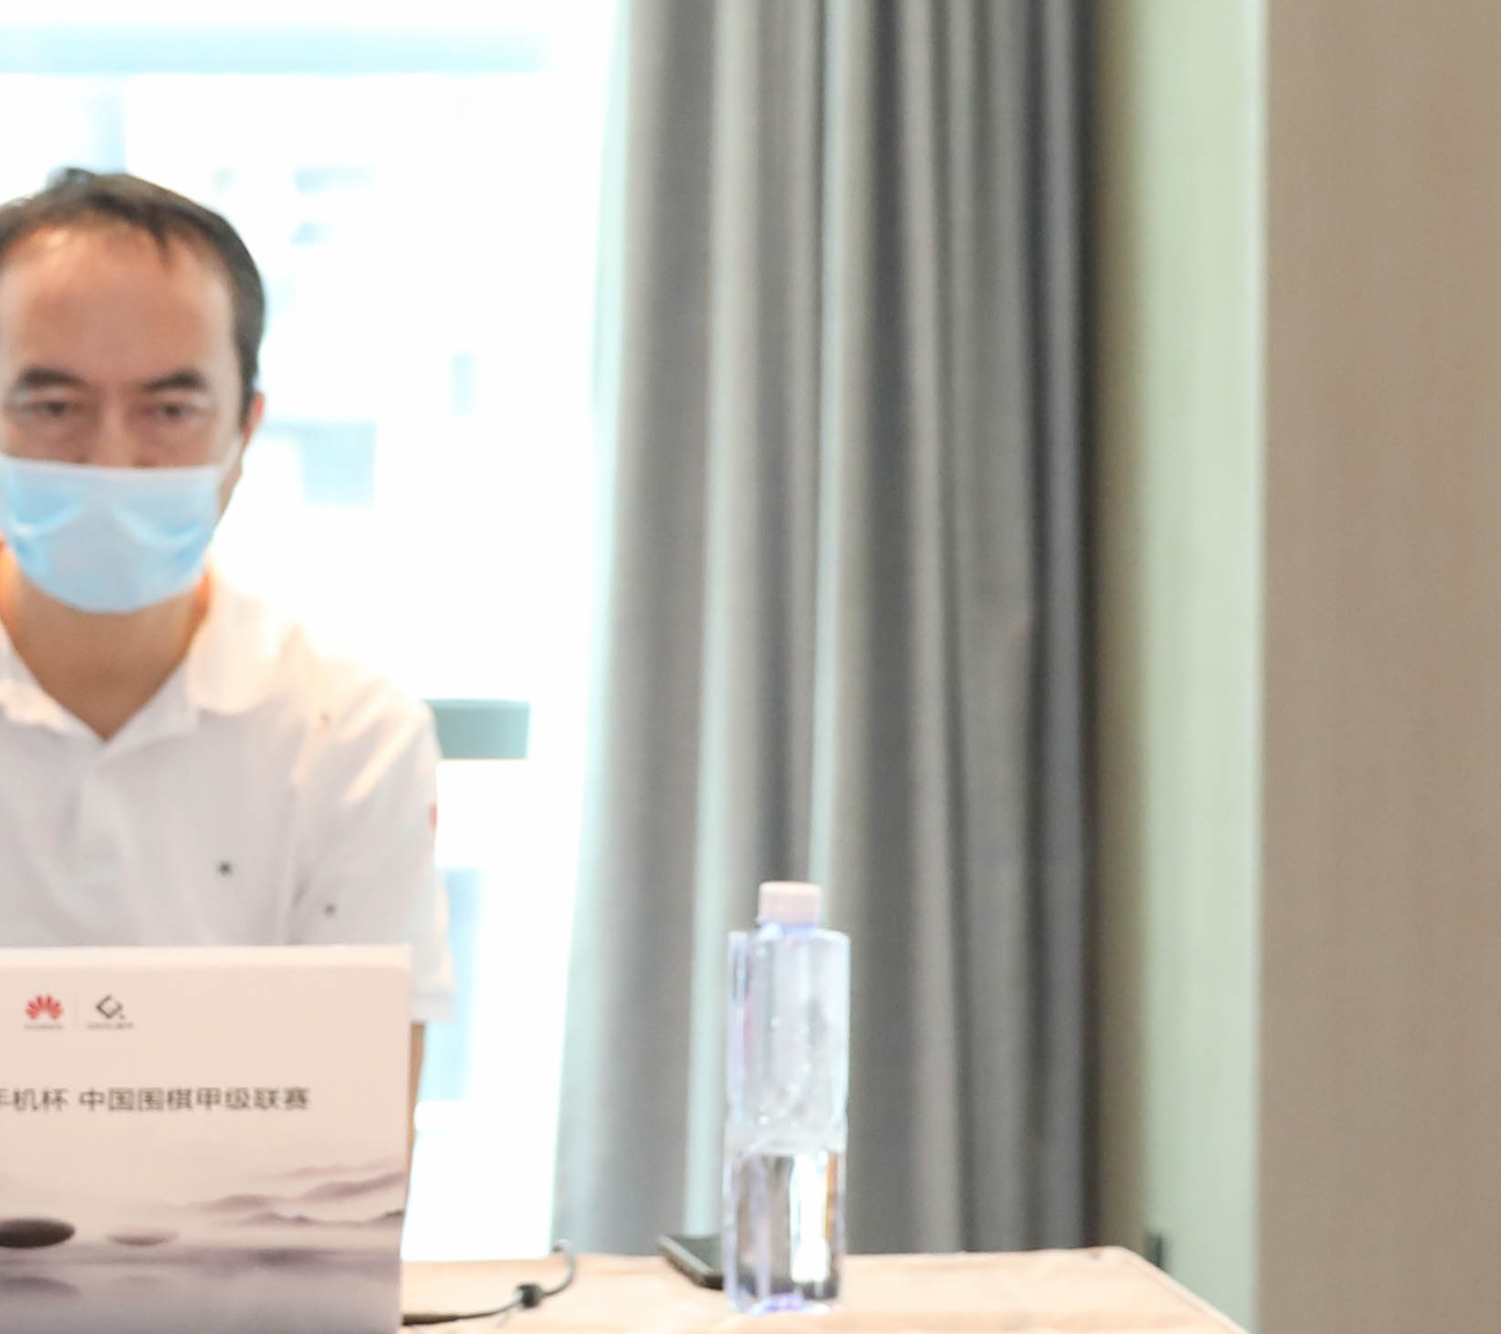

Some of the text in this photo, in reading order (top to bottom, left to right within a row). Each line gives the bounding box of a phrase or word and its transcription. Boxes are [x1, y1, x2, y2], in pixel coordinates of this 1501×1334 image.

[78, 1086, 311, 1113] 中国围棋甲级联赛
